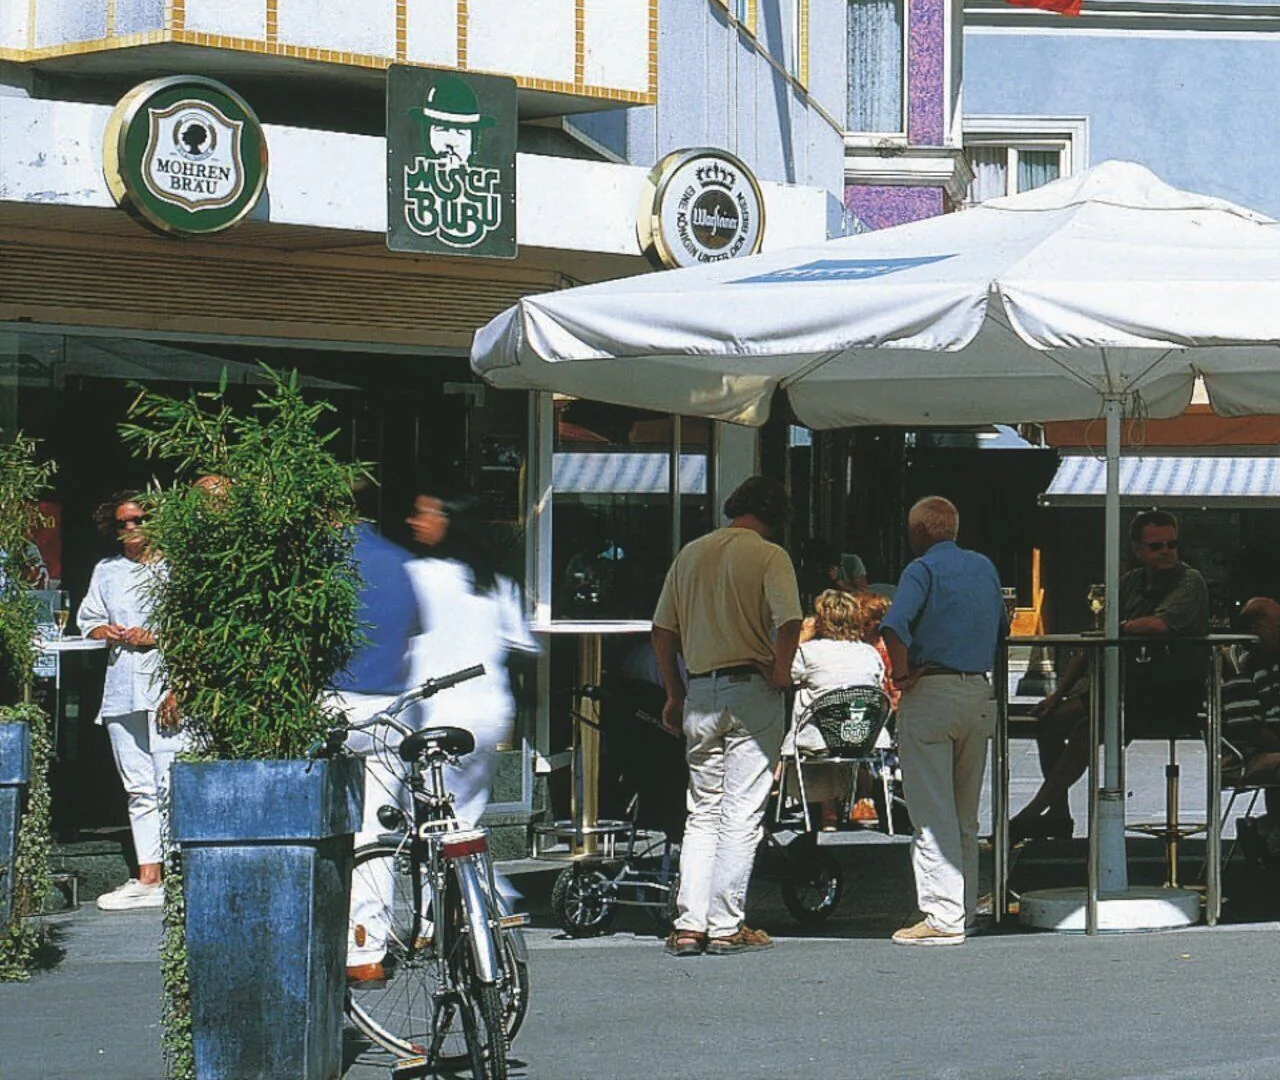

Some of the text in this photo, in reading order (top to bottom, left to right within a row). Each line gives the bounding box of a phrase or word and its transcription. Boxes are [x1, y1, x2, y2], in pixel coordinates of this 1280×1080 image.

[157, 159, 231, 181] MOHREN
[170, 176, 217, 194] BRÄU
[678, 185, 696, 210] EINE
